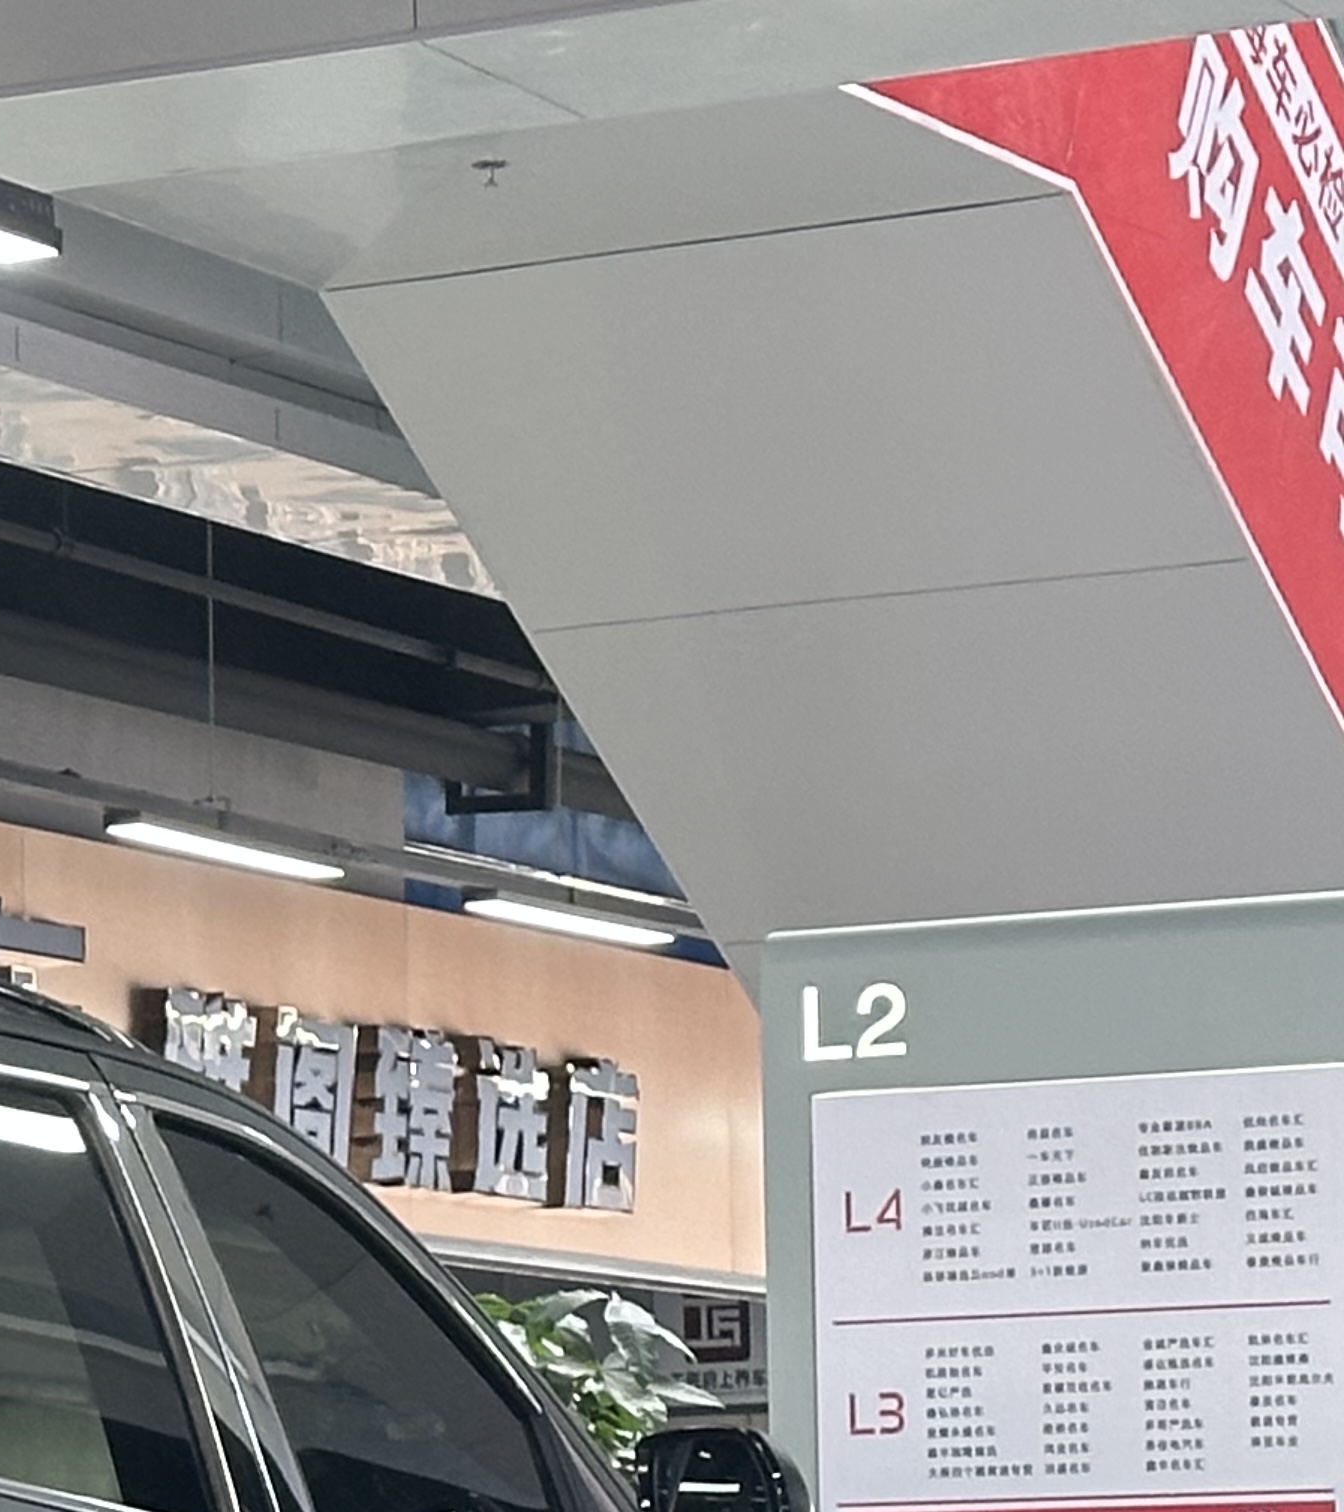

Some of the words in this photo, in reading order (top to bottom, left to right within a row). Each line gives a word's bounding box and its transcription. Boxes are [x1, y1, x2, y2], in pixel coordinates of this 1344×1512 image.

[802, 983, 907, 1062] L2
[845, 1188, 903, 1233] L4
[849, 1391, 905, 1435] L3
